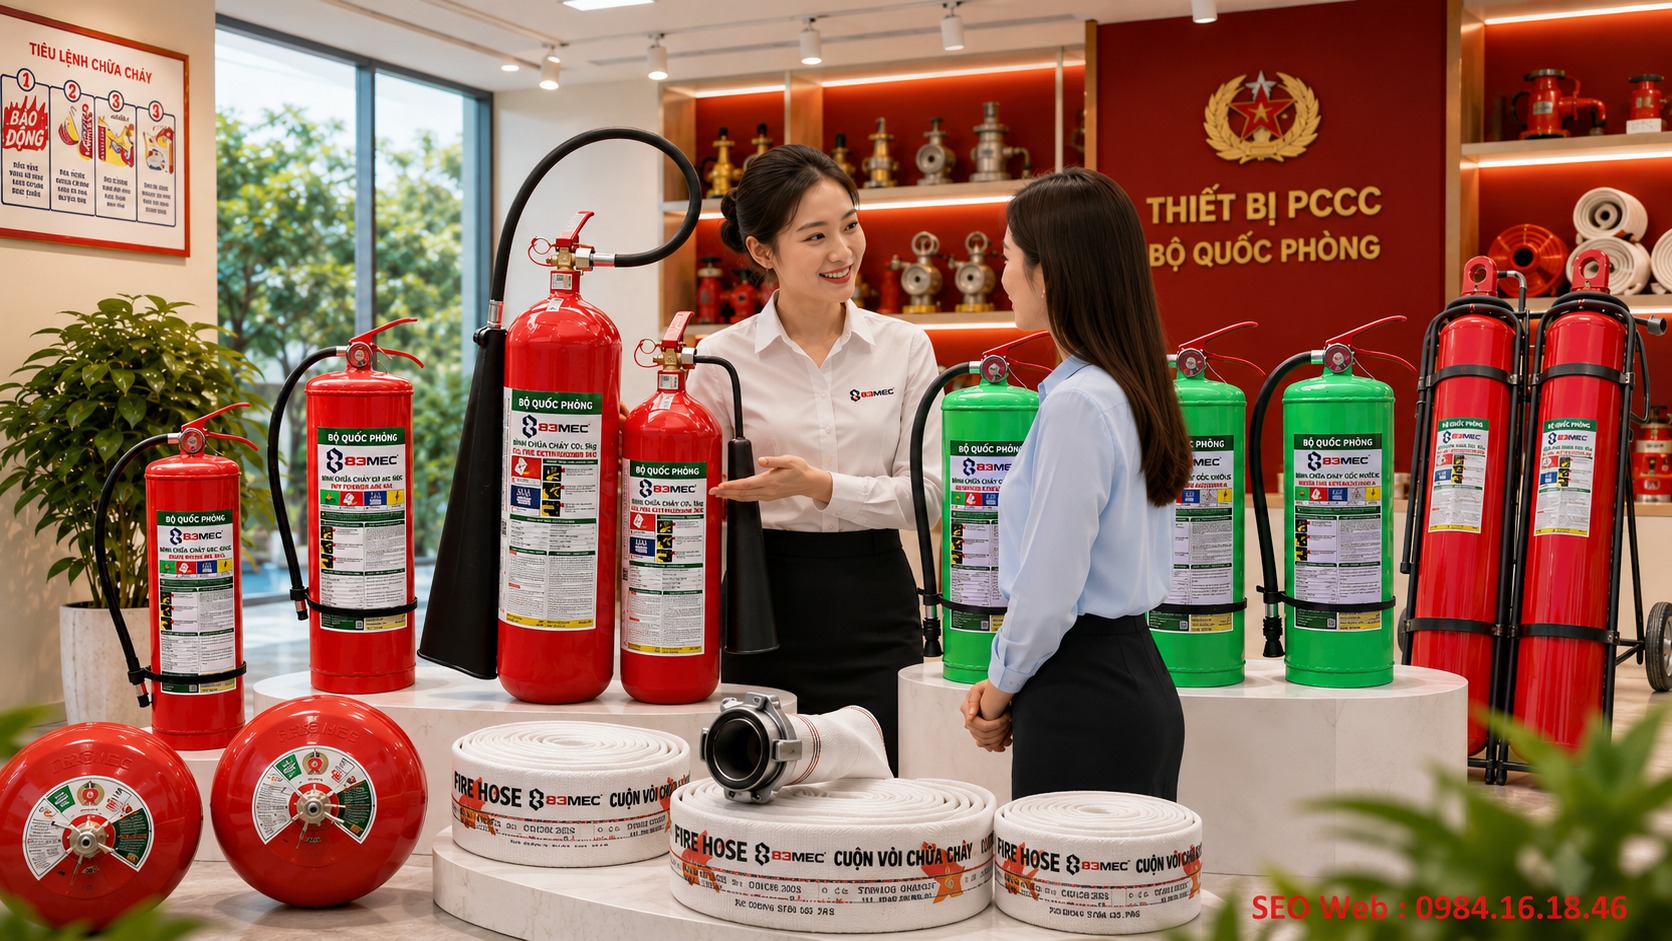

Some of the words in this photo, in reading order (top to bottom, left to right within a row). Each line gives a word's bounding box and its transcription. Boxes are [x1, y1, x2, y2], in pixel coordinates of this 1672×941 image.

[29, 42, 56, 60] TIÊU
[59, 48, 88, 68] LỆNH
[91, 57, 122, 77] CHỮA
[125, 66, 152, 84] CHÁY
[23, 72, 29, 88] 1
[68, 83, 76, 99] 2
[112, 94, 120, 109] 3
[152, 104, 160, 118] 3
[1146, 184, 1236, 224] THIẾT
[1246, 192, 1276, 226] BỊ
[1288, 187, 1382, 218] PCCC
[1149, 237, 1186, 272] BỘ
[1193, 231, 1272, 267] QUỐC
[1280, 231, 1381, 262] PHÒNG
[532, 397, 558, 410] QUỐC
[342, 431, 367, 444] QUỐC
[971, 443, 994, 454] QUỐC
[1316, 437, 1341, 448] QUỐC
[647, 465, 670, 476] QUỐC
[178, 514, 199, 524] QUỐC
[455, 770, 474, 798] FIRE
[478, 781, 522, 808] HOSE
[610, 788, 640, 809] CUỘN
[675, 824, 698, 852] FIRE
[703, 835, 747, 862] HOSE
[834, 847, 873, 871] CUỘN
[878, 846, 903, 867] VÒI
[998, 837, 1017, 863] FIRE
[1021, 848, 1060, 872] HOSE
[1136, 854, 1164, 876] CUỘN
